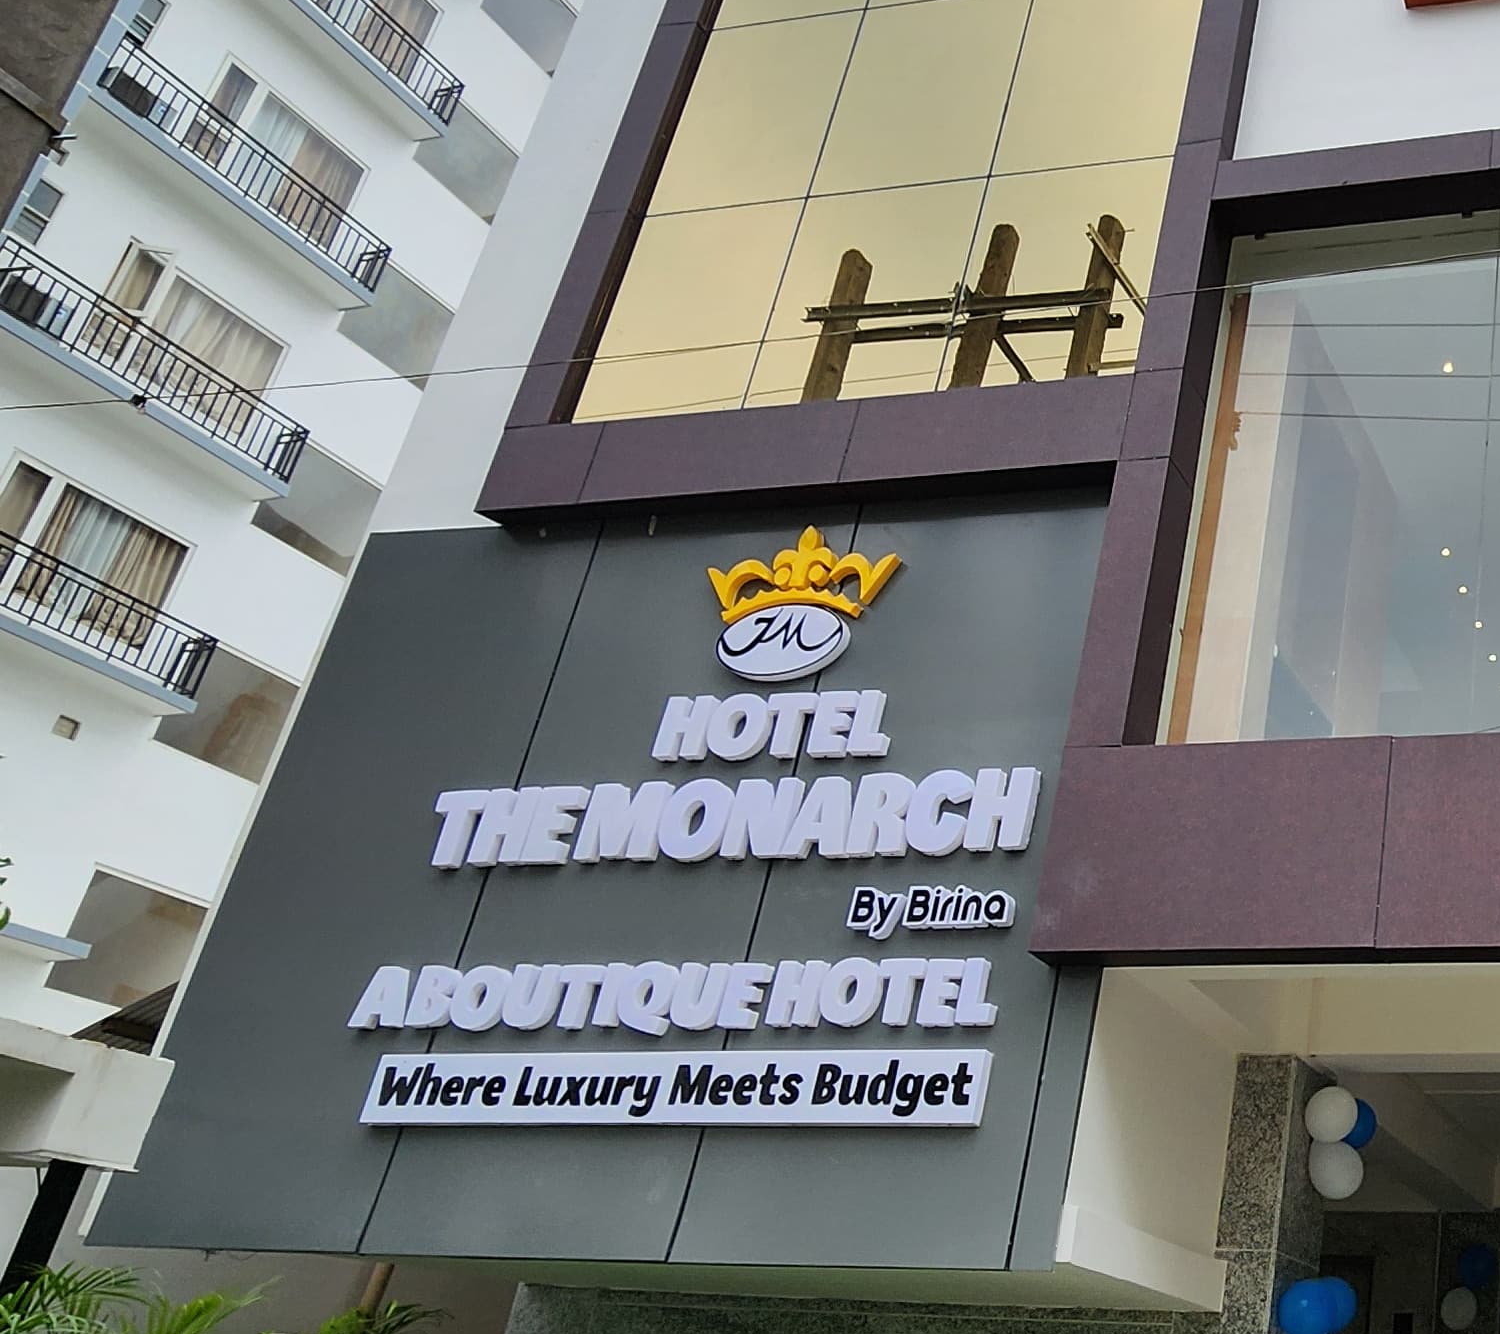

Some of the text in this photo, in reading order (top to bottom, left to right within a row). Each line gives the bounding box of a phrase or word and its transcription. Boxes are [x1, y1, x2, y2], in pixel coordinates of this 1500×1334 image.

[651, 690, 890, 761] HOTEL
[431, 767, 1041, 870] THE MONARCH
[849, 886, 1009, 936] By Birina
[765, 956, 998, 1028] HOTEL
[377, 1058, 974, 1118] Where Luxury Meets Budget
